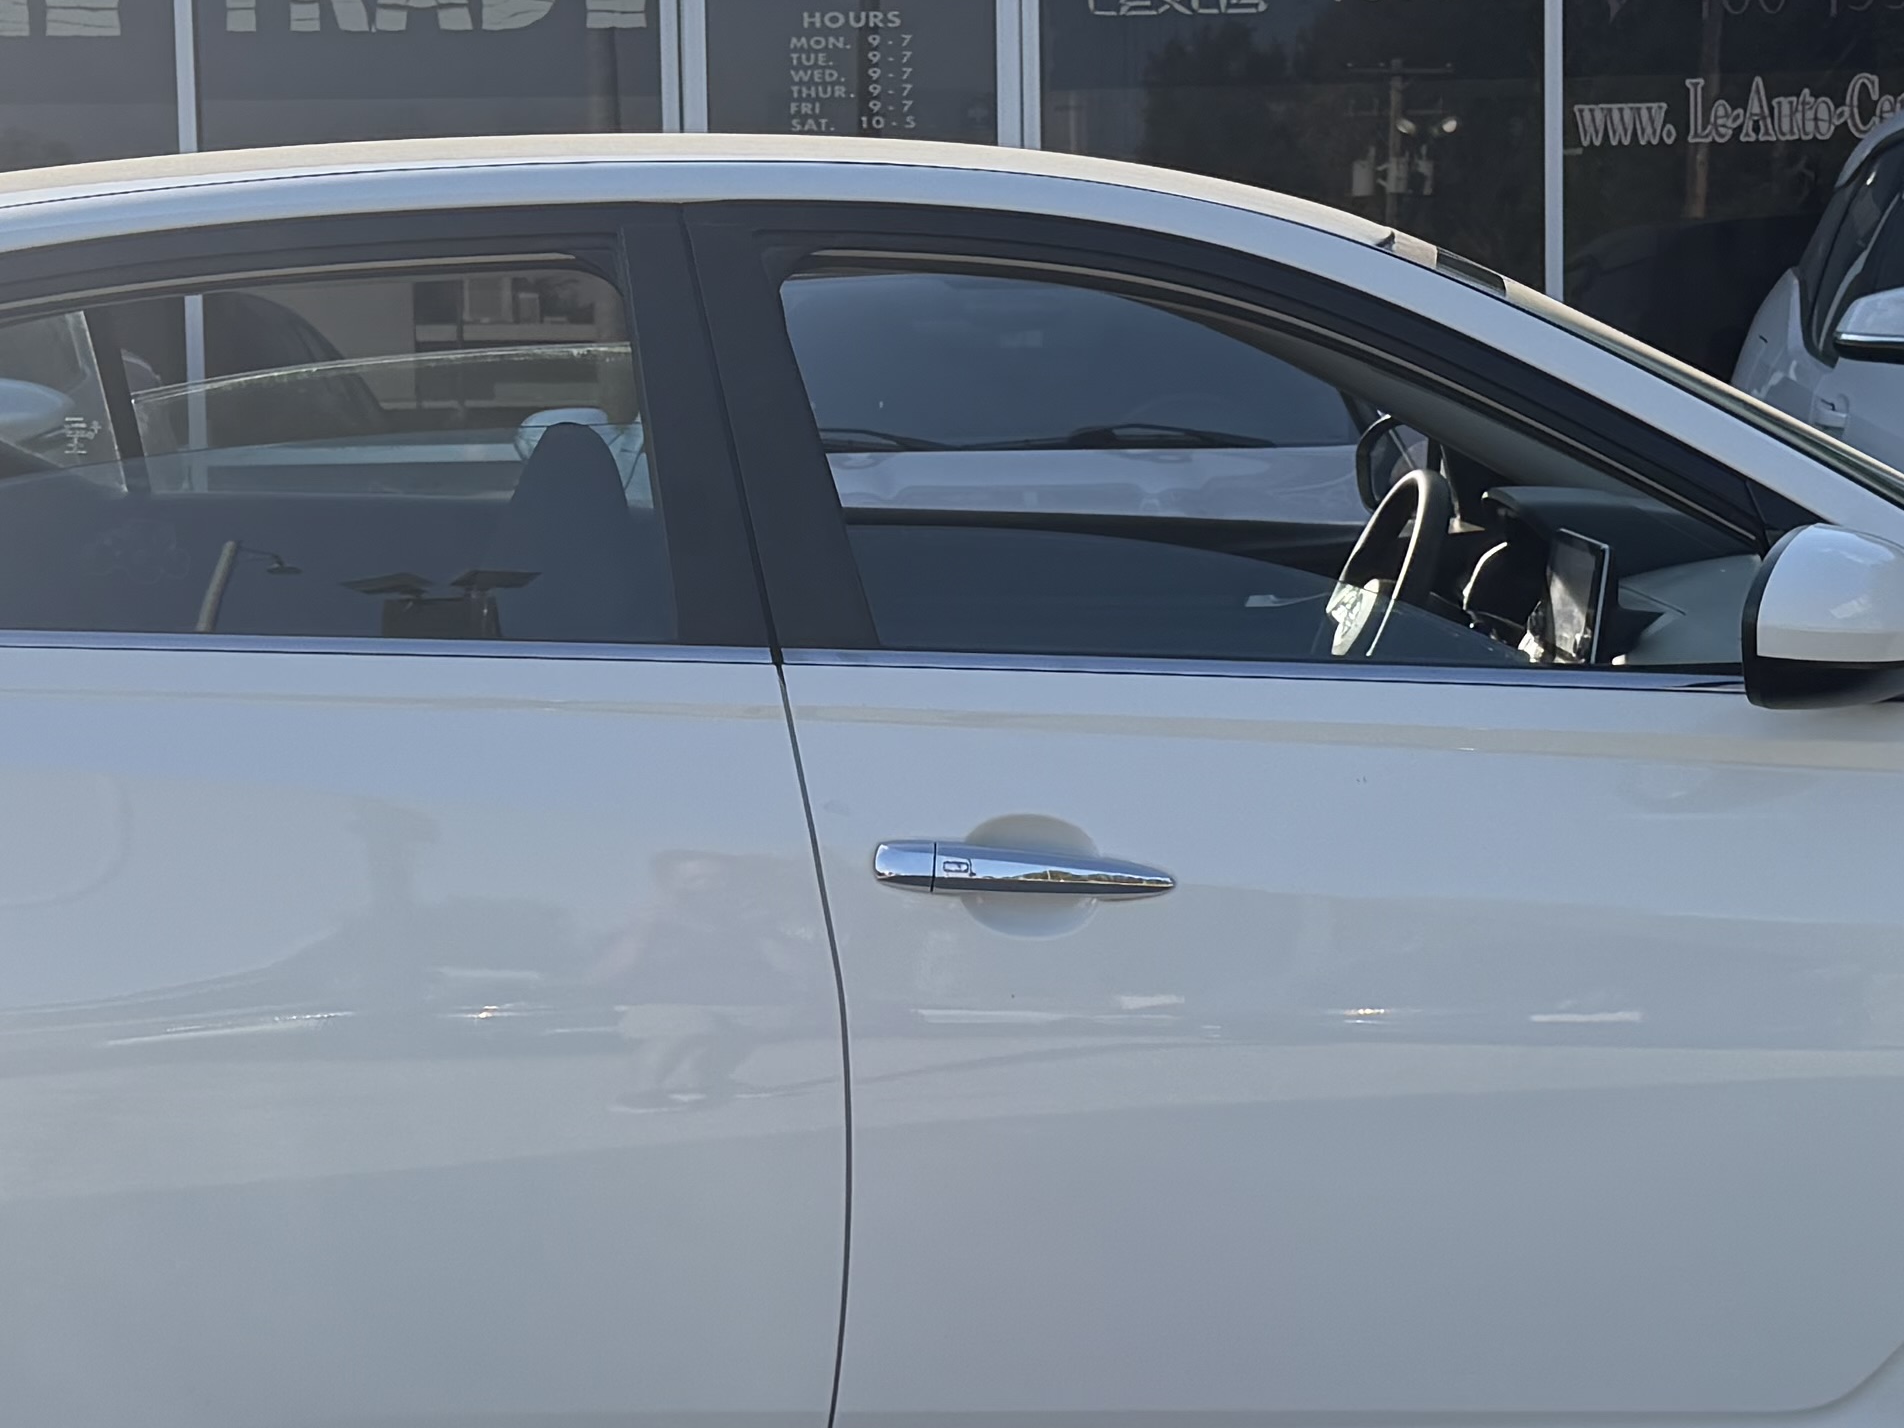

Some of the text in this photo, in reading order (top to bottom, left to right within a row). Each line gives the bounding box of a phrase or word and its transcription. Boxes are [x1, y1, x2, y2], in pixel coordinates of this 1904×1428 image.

[802, 10, 902, 29] HOURS
[789, 36, 851, 50] MON.
[789, 52, 834, 66] TUE.
[790, 69, 846, 83] WED.
[790, 85, 855, 99] THUR.
[790, 118, 836, 131] SAT.
[1573, 102, 1676, 147] www.
